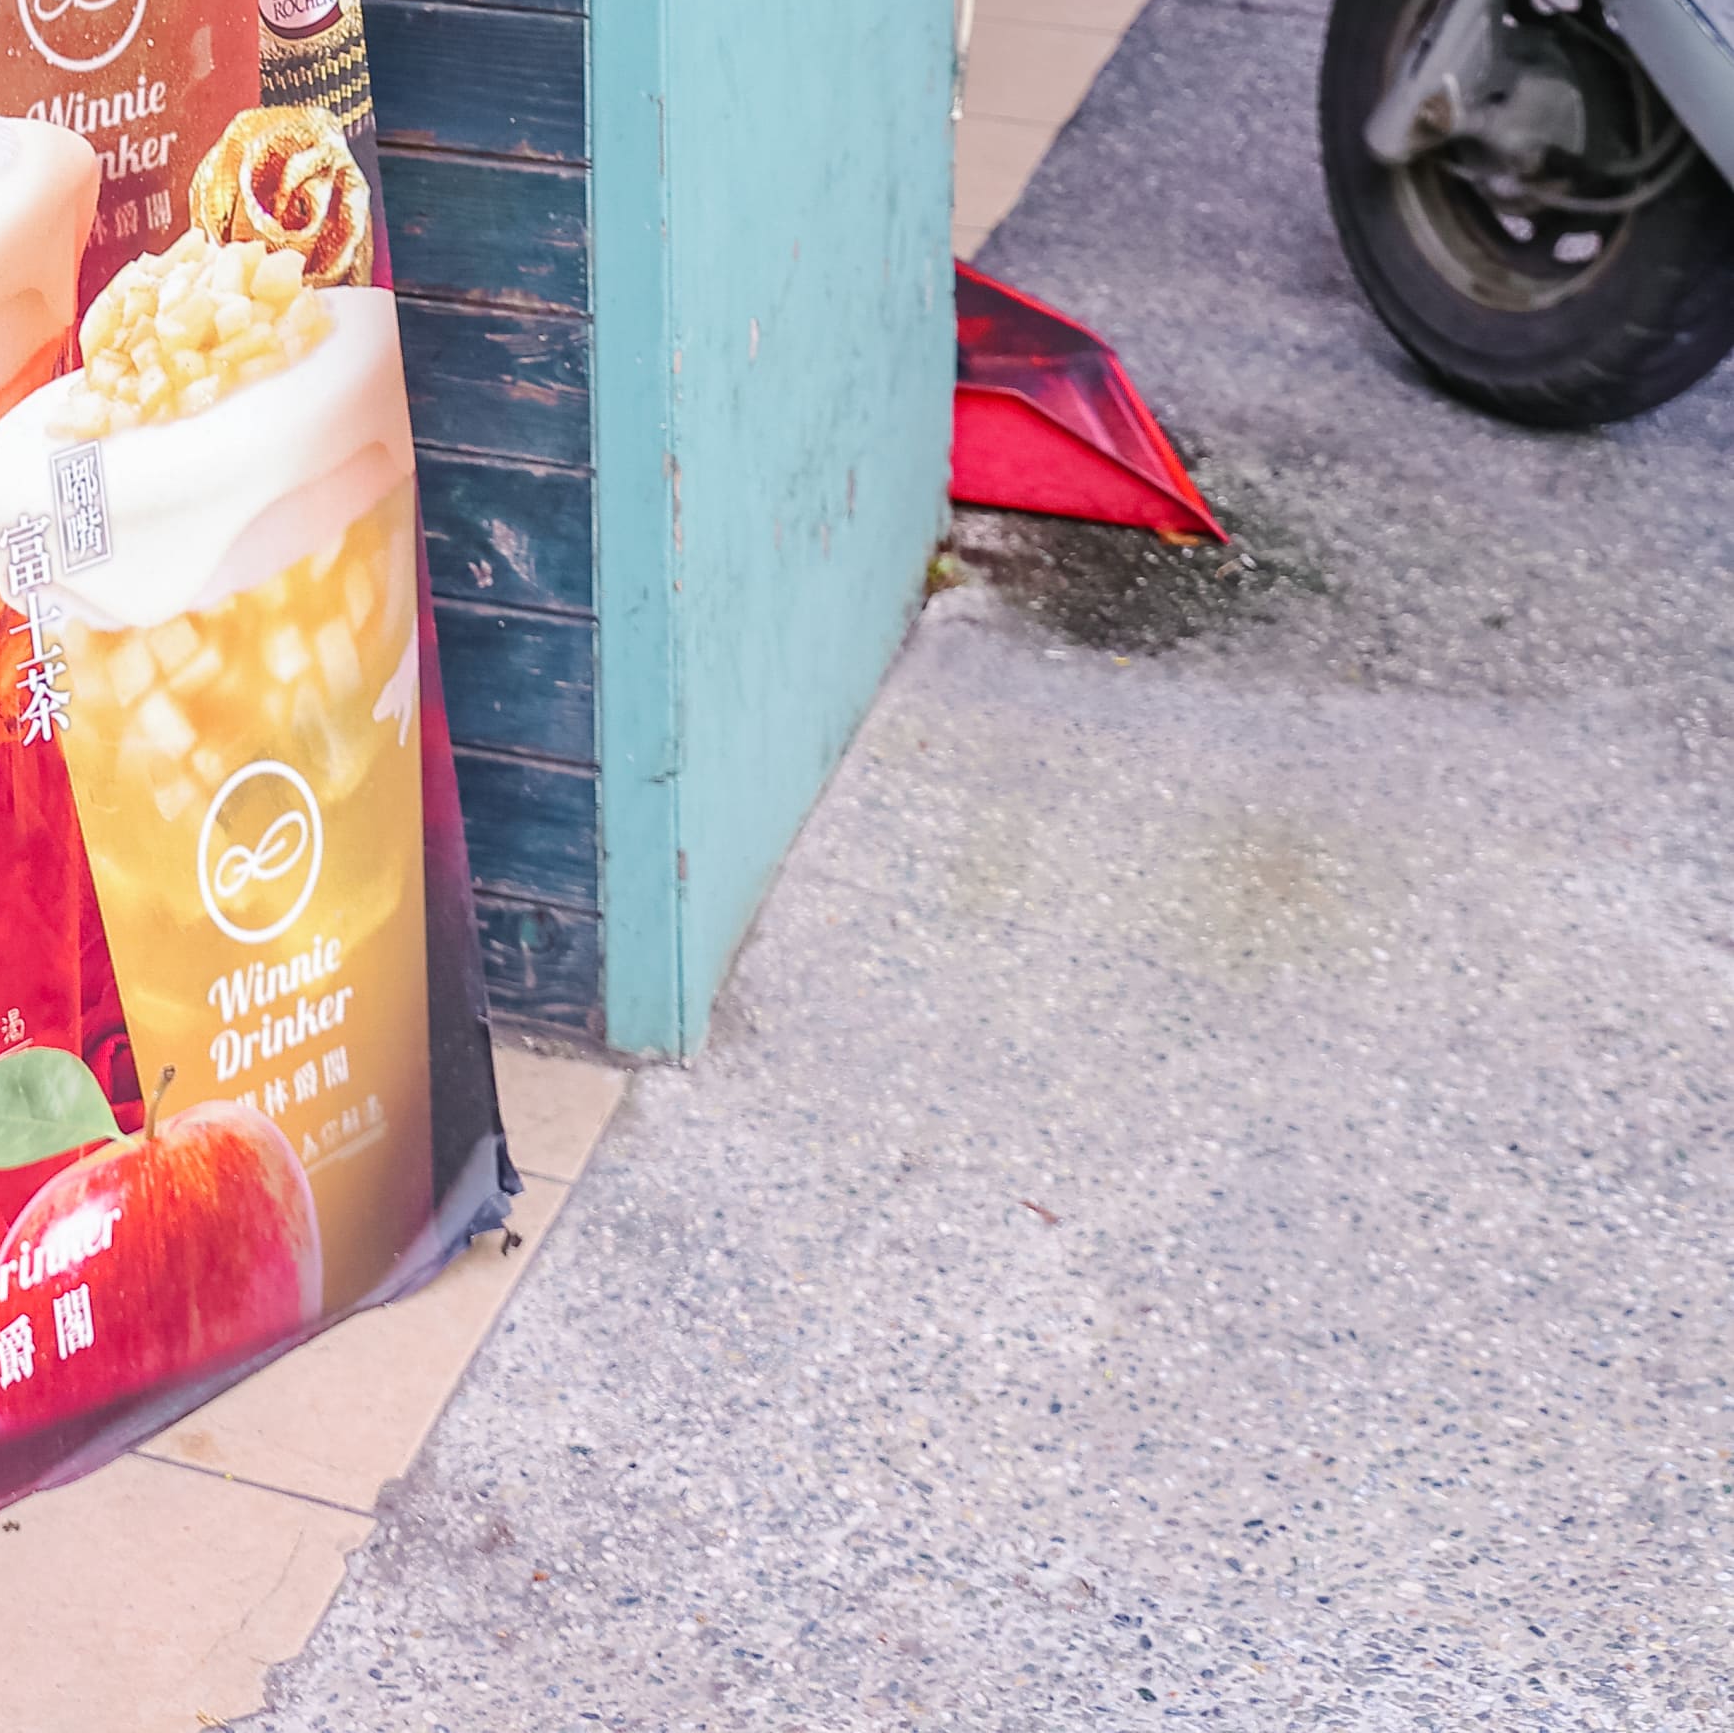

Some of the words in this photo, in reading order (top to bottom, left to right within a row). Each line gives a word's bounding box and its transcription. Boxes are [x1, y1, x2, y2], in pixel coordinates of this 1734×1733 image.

[97, 131, 178, 181] nker
[60, 454, 102, 559] 嘟嘴
[207, 933, 343, 1024] Winnie
[209, 985, 355, 1084] Drinker
